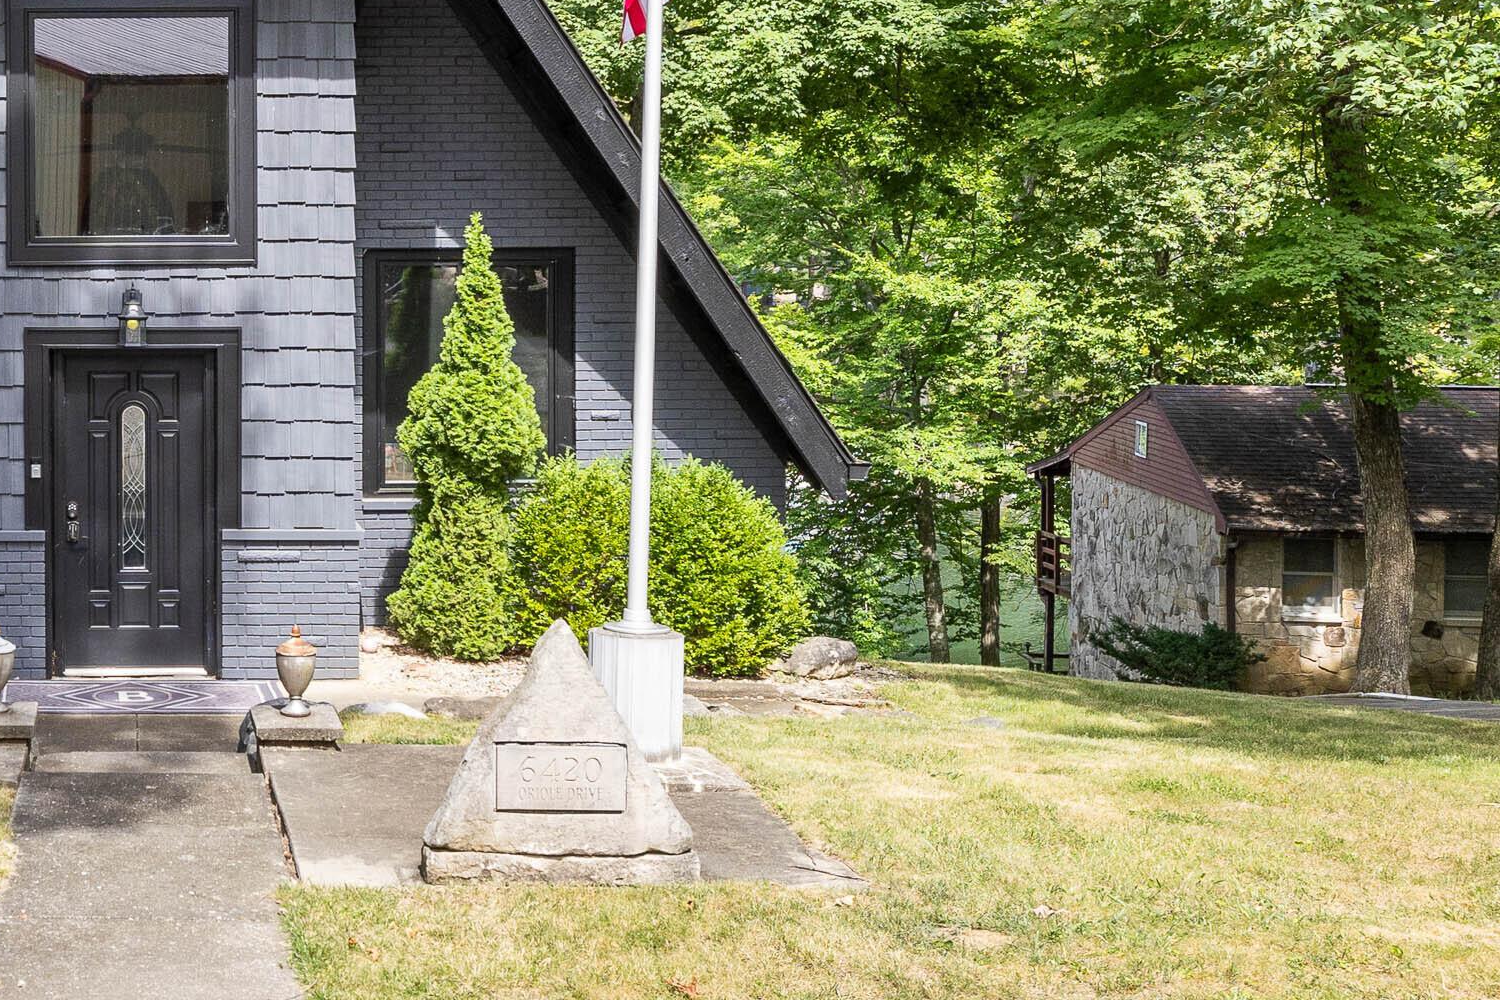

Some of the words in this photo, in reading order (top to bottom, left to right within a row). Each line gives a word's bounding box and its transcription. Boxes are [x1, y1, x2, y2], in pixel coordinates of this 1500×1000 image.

[115, 690, 154, 702] B
[519, 756, 602, 782] 6420
[518, 786, 562, 801] ORIOLE
[567, 786, 605, 801] DRIVE
